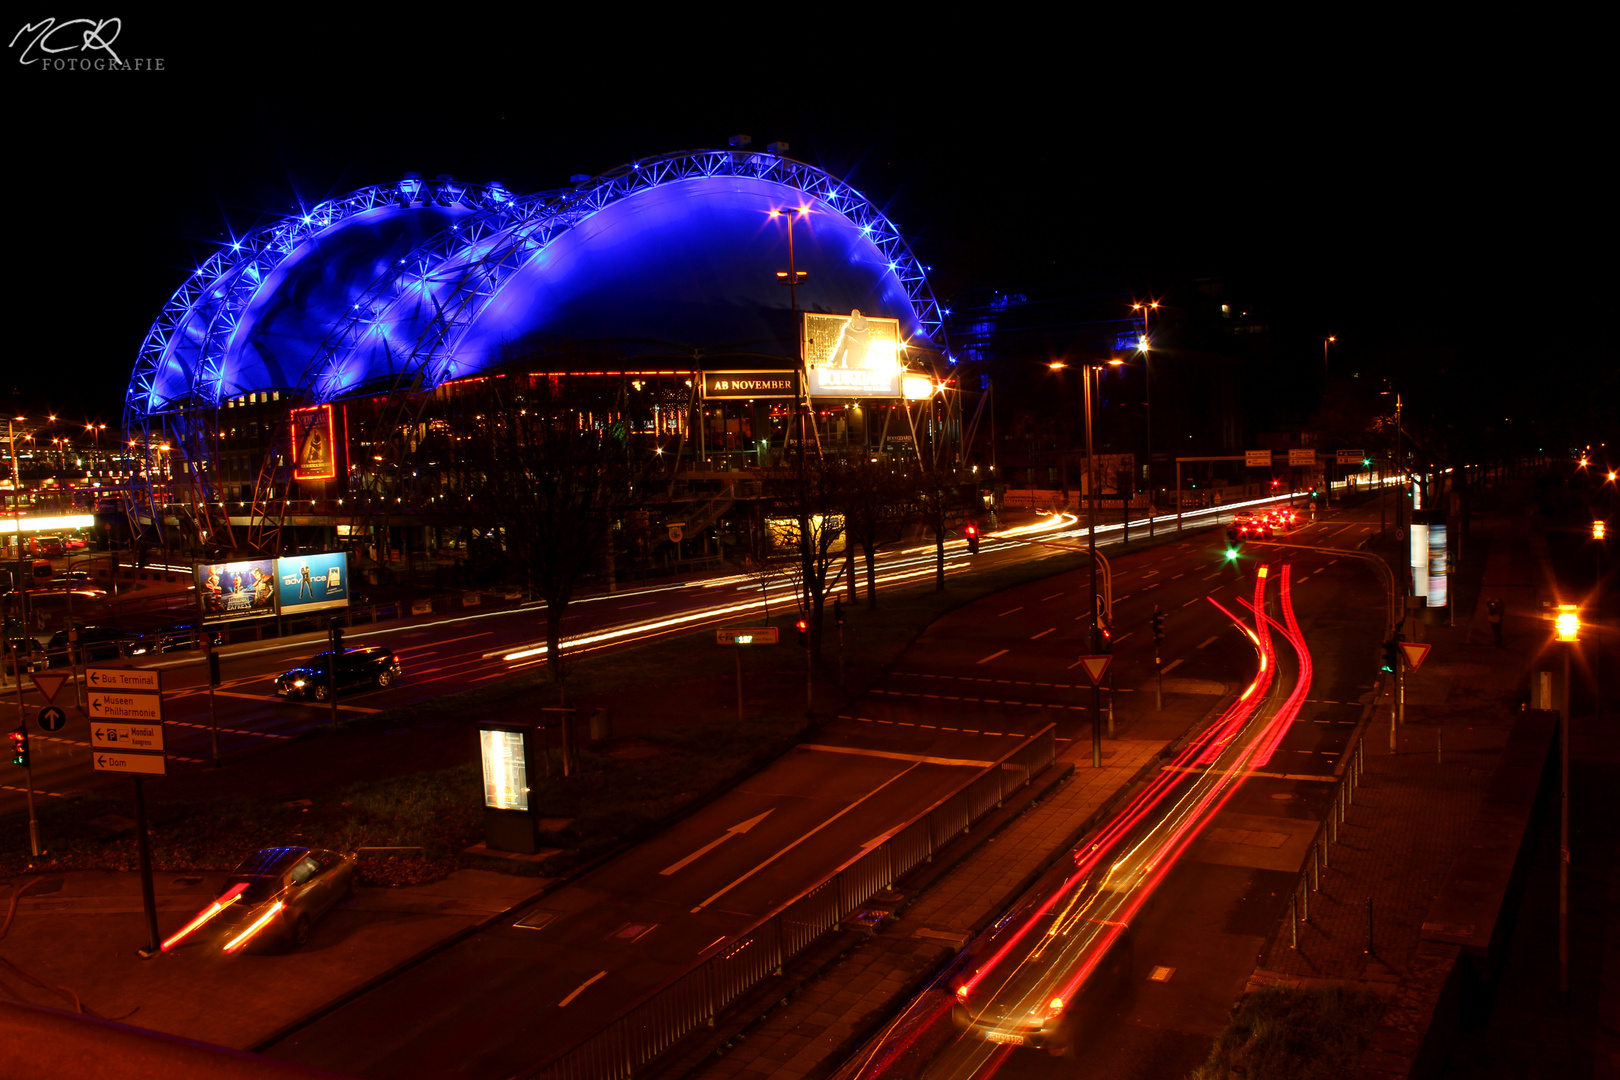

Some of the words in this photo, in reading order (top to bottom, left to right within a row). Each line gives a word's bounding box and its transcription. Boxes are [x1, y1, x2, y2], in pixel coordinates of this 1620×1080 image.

[714, 380, 729, 391] AB
[731, 380, 792, 390] NOVEMBER
[284, 575, 327, 586] advnce
[102, 674, 116, 684] Bus
[120, 675, 154, 685] Terminal
[103, 696, 134, 706] Museen
[104, 707, 156, 718] Philharmonie
[131, 727, 154, 737] Mondial
[132, 738, 152, 747] Kongress
[109, 758, 127, 767] Dom
